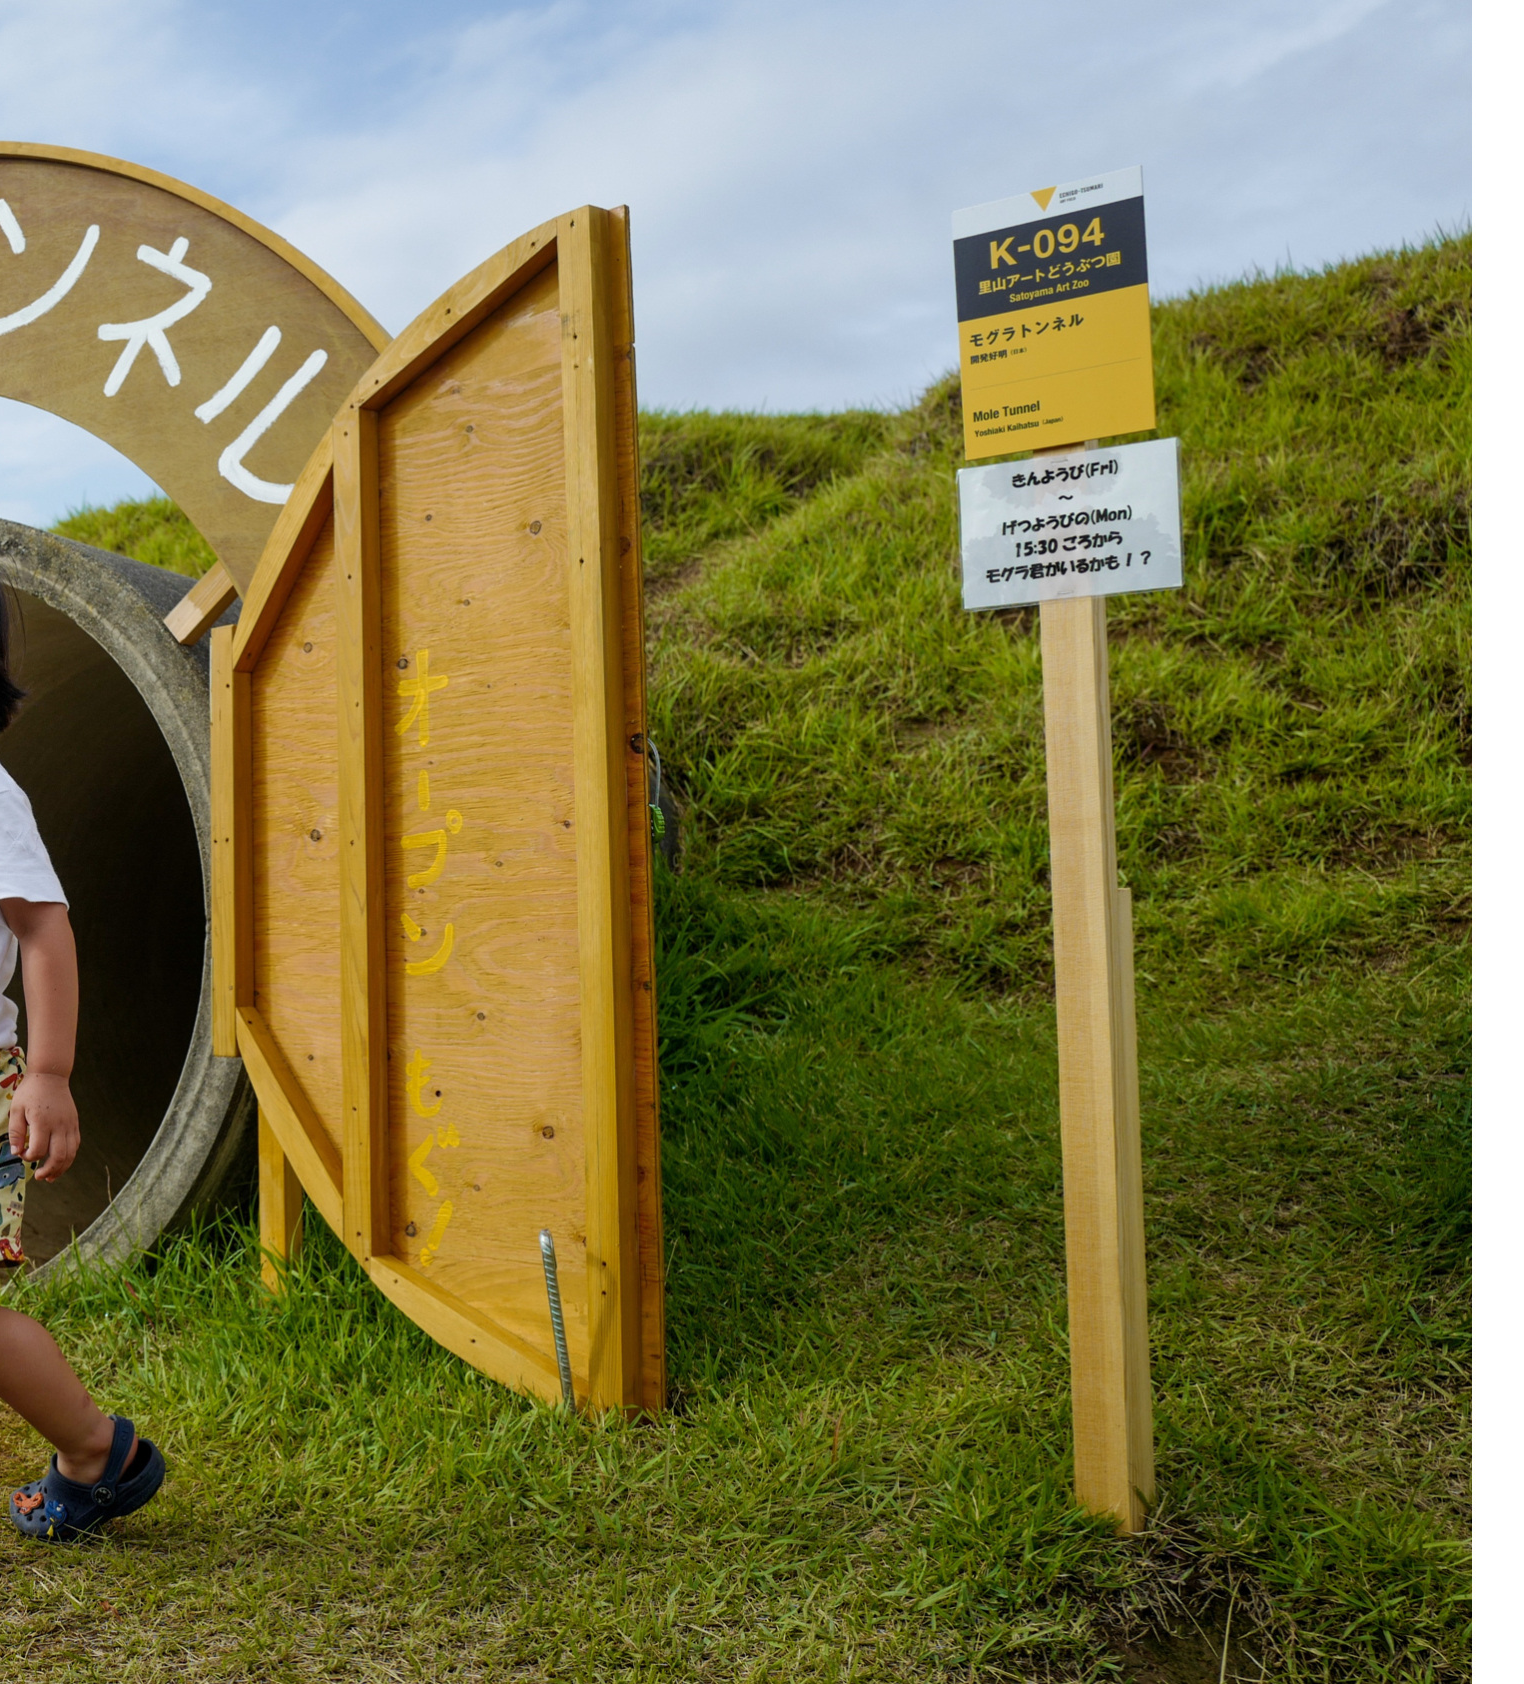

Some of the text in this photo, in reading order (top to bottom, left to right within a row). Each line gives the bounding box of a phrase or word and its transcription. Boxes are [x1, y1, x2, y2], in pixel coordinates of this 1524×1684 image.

[989, 217, 1106, 270] K-094
[978, 251, 1122, 295] 里山アートどうぶつ園
[1009, 279, 1090, 304] Satoyama Art Zoo
[969, 313, 1084, 347] モグラトンネル
[973, 400, 1041, 423] Mole Tunnel
[974, 425, 1006, 437] Yoshiaki
[1007, 421, 1040, 432] Kaihatsu
[1015, 531, 1123, 558] 15:30 ごろから
[394, 648, 463, 976] オープン
